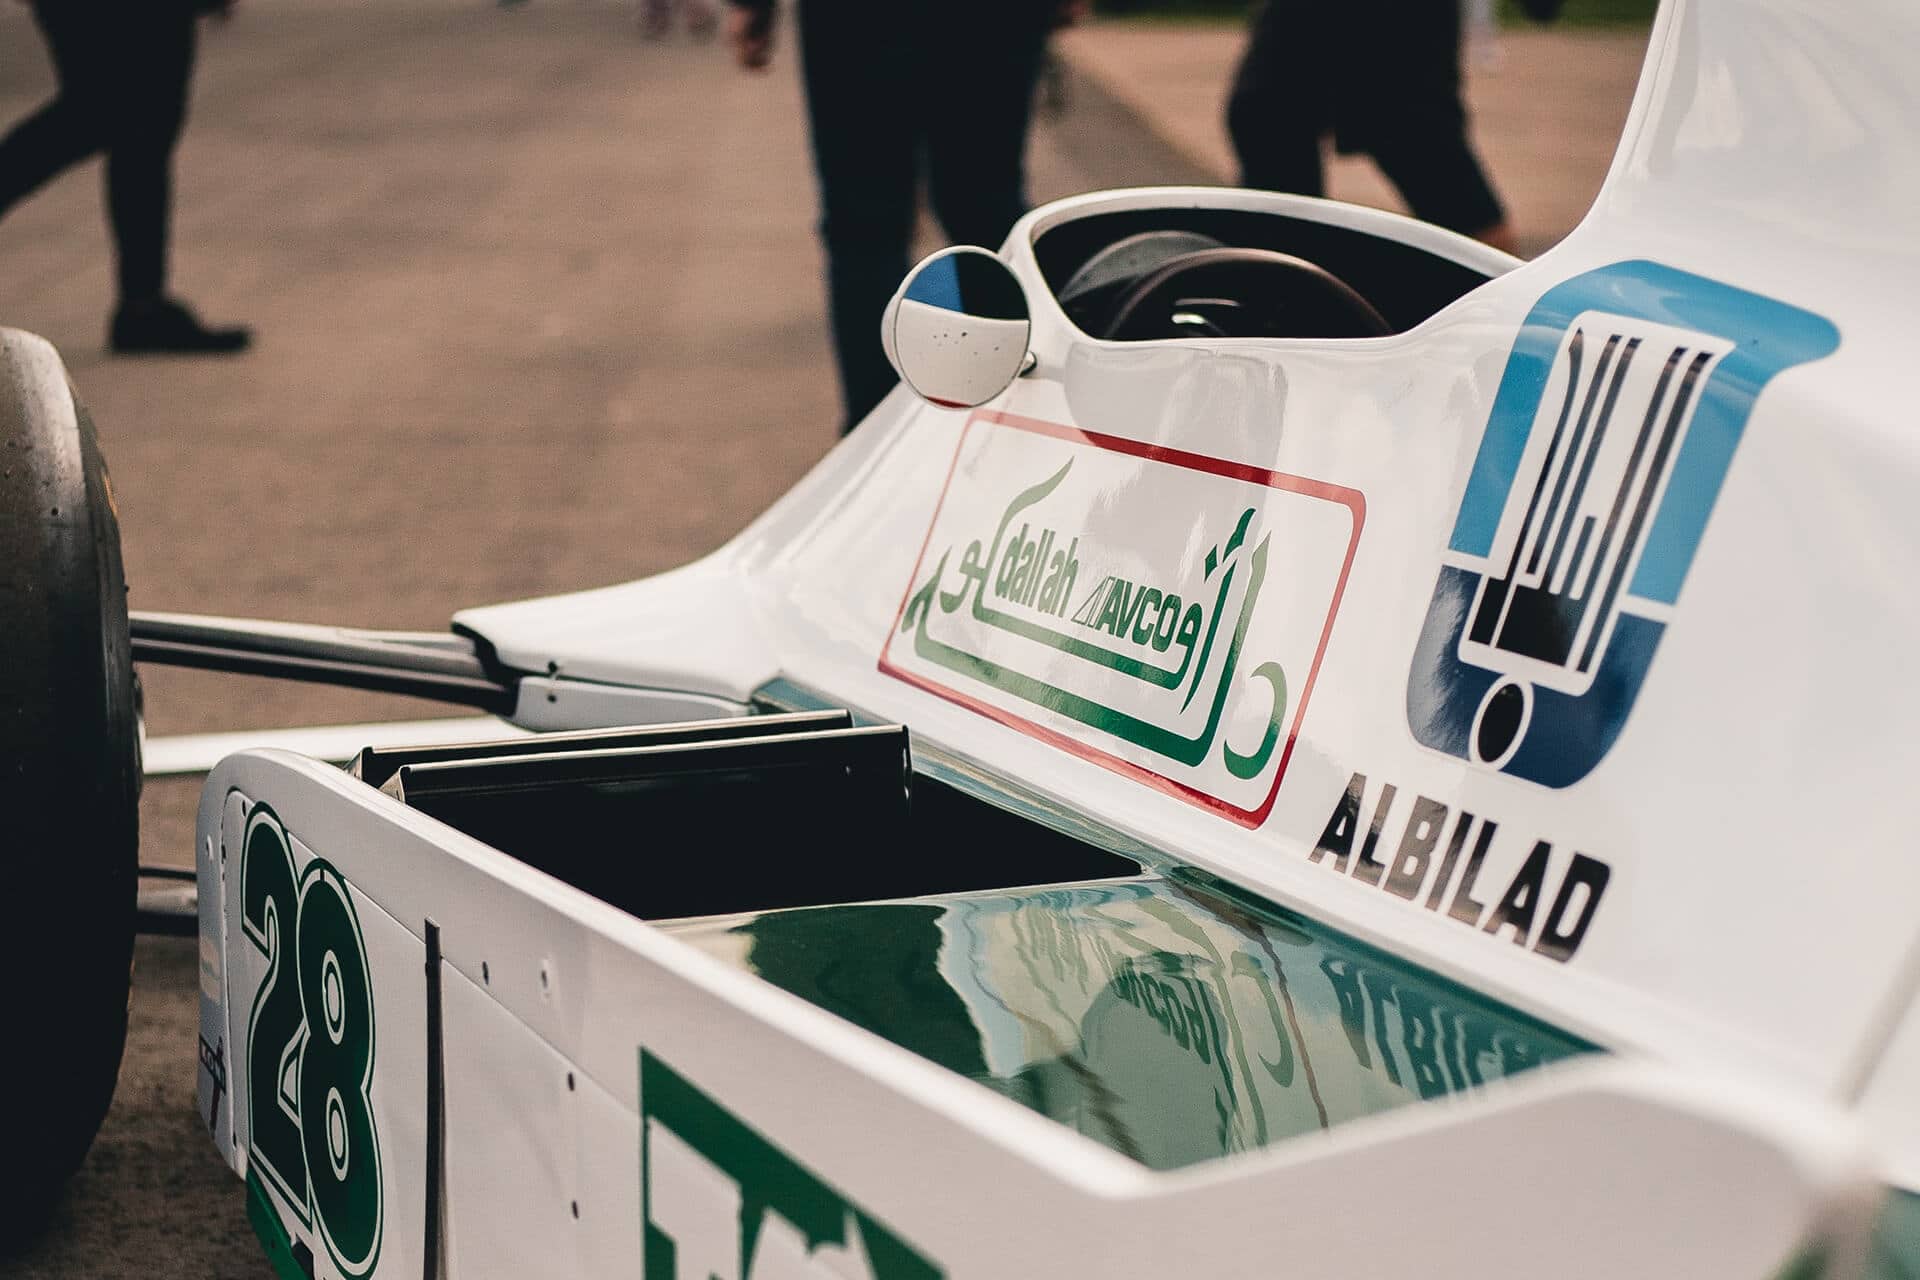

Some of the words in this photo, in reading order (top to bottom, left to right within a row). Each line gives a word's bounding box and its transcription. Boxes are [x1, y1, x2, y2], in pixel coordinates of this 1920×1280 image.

[995, 522, 1078, 618] dallah
[1094, 576, 1182, 653] AVCO
[1308, 772, 1611, 964] ALBILAD
[241, 800, 384, 1280] 28
